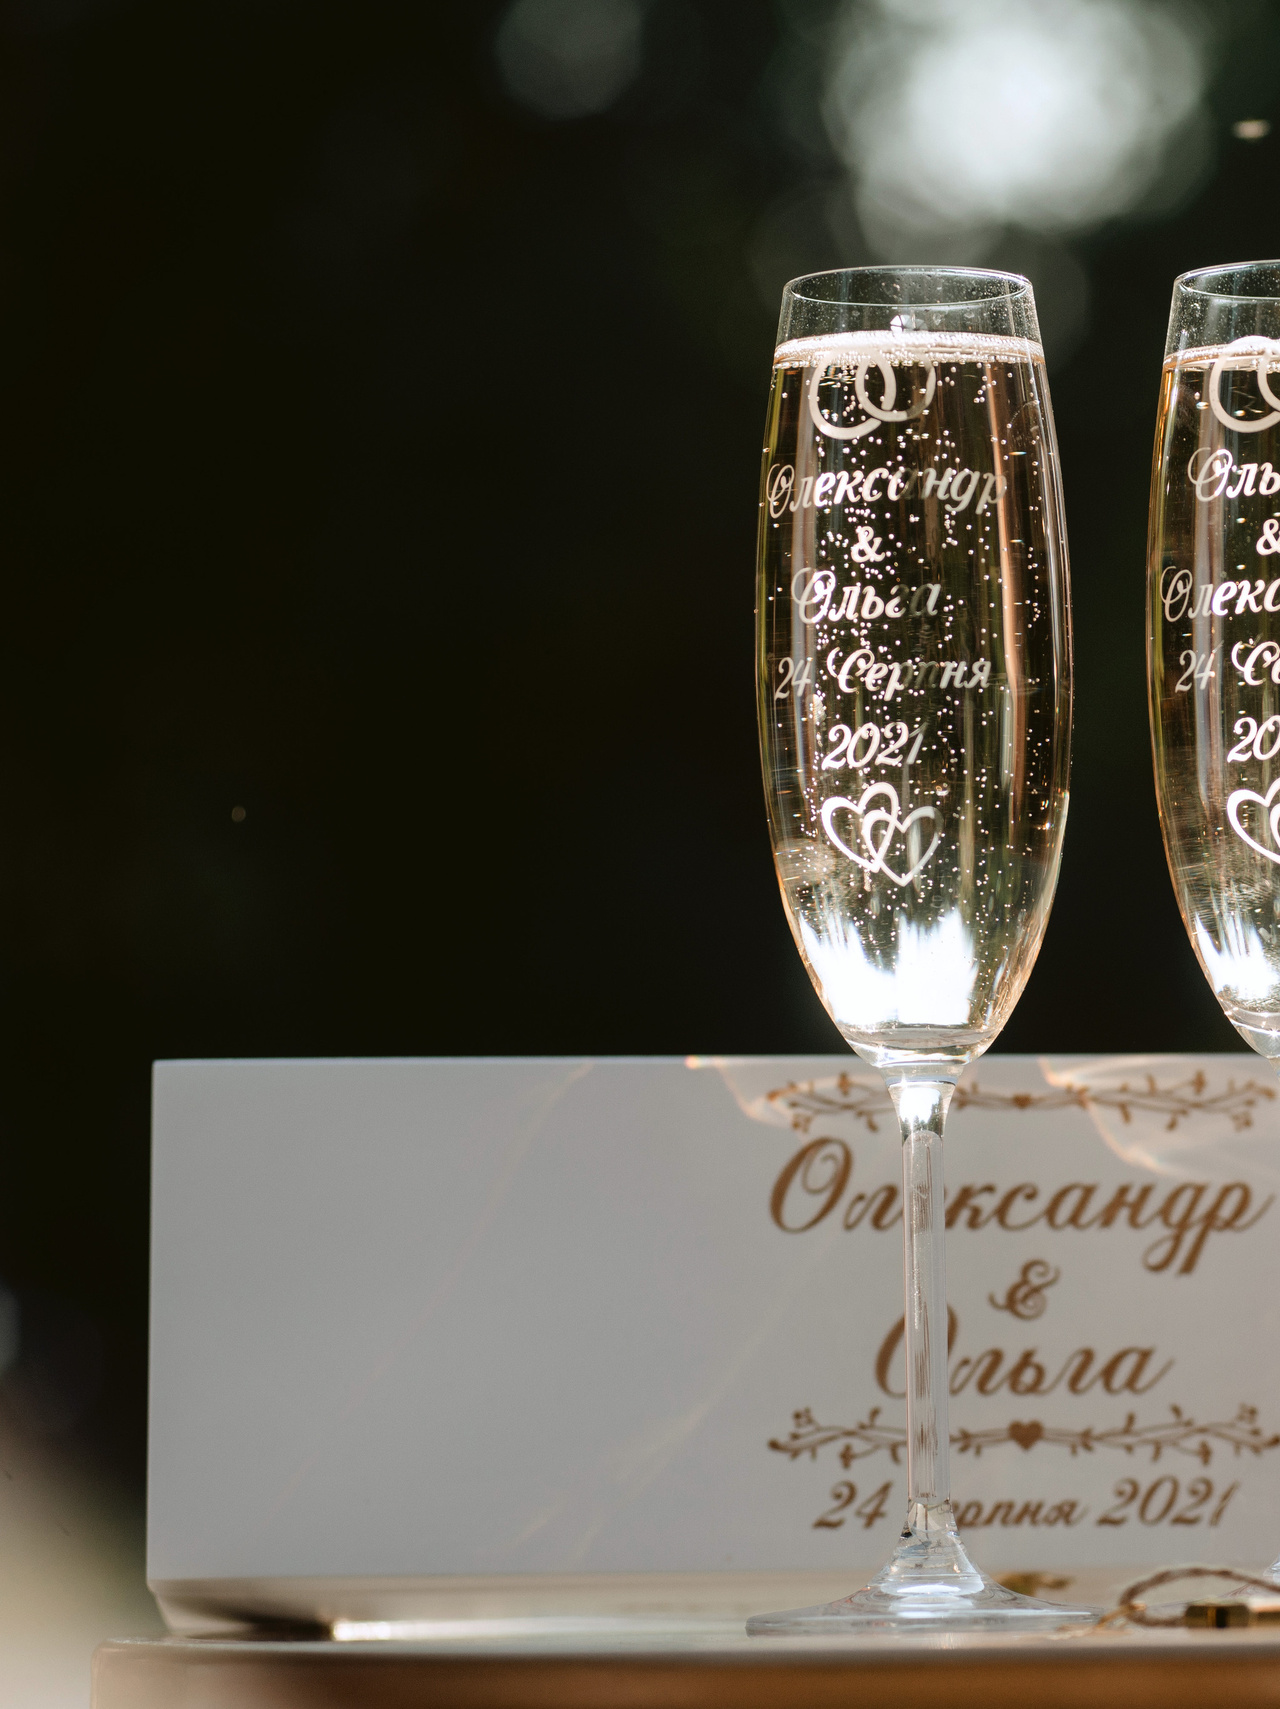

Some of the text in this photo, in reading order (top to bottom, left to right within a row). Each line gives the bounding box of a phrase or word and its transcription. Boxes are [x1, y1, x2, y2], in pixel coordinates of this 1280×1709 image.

[766, 463, 1007, 518] Олександр
[850, 526, 886, 563] &
[791, 567, 942, 624] Ольга
[774, 647, 992, 702] 24 Серпня
[1175, 648, 1217, 694] 24
[821, 721, 928, 772] 2021
[769, 1136, 1277, 1275] Олксандр
[988, 1259, 1060, 1321] &
[811, 1479, 895, 1530] 24
[1096, 1475, 1242, 1529] 2021
